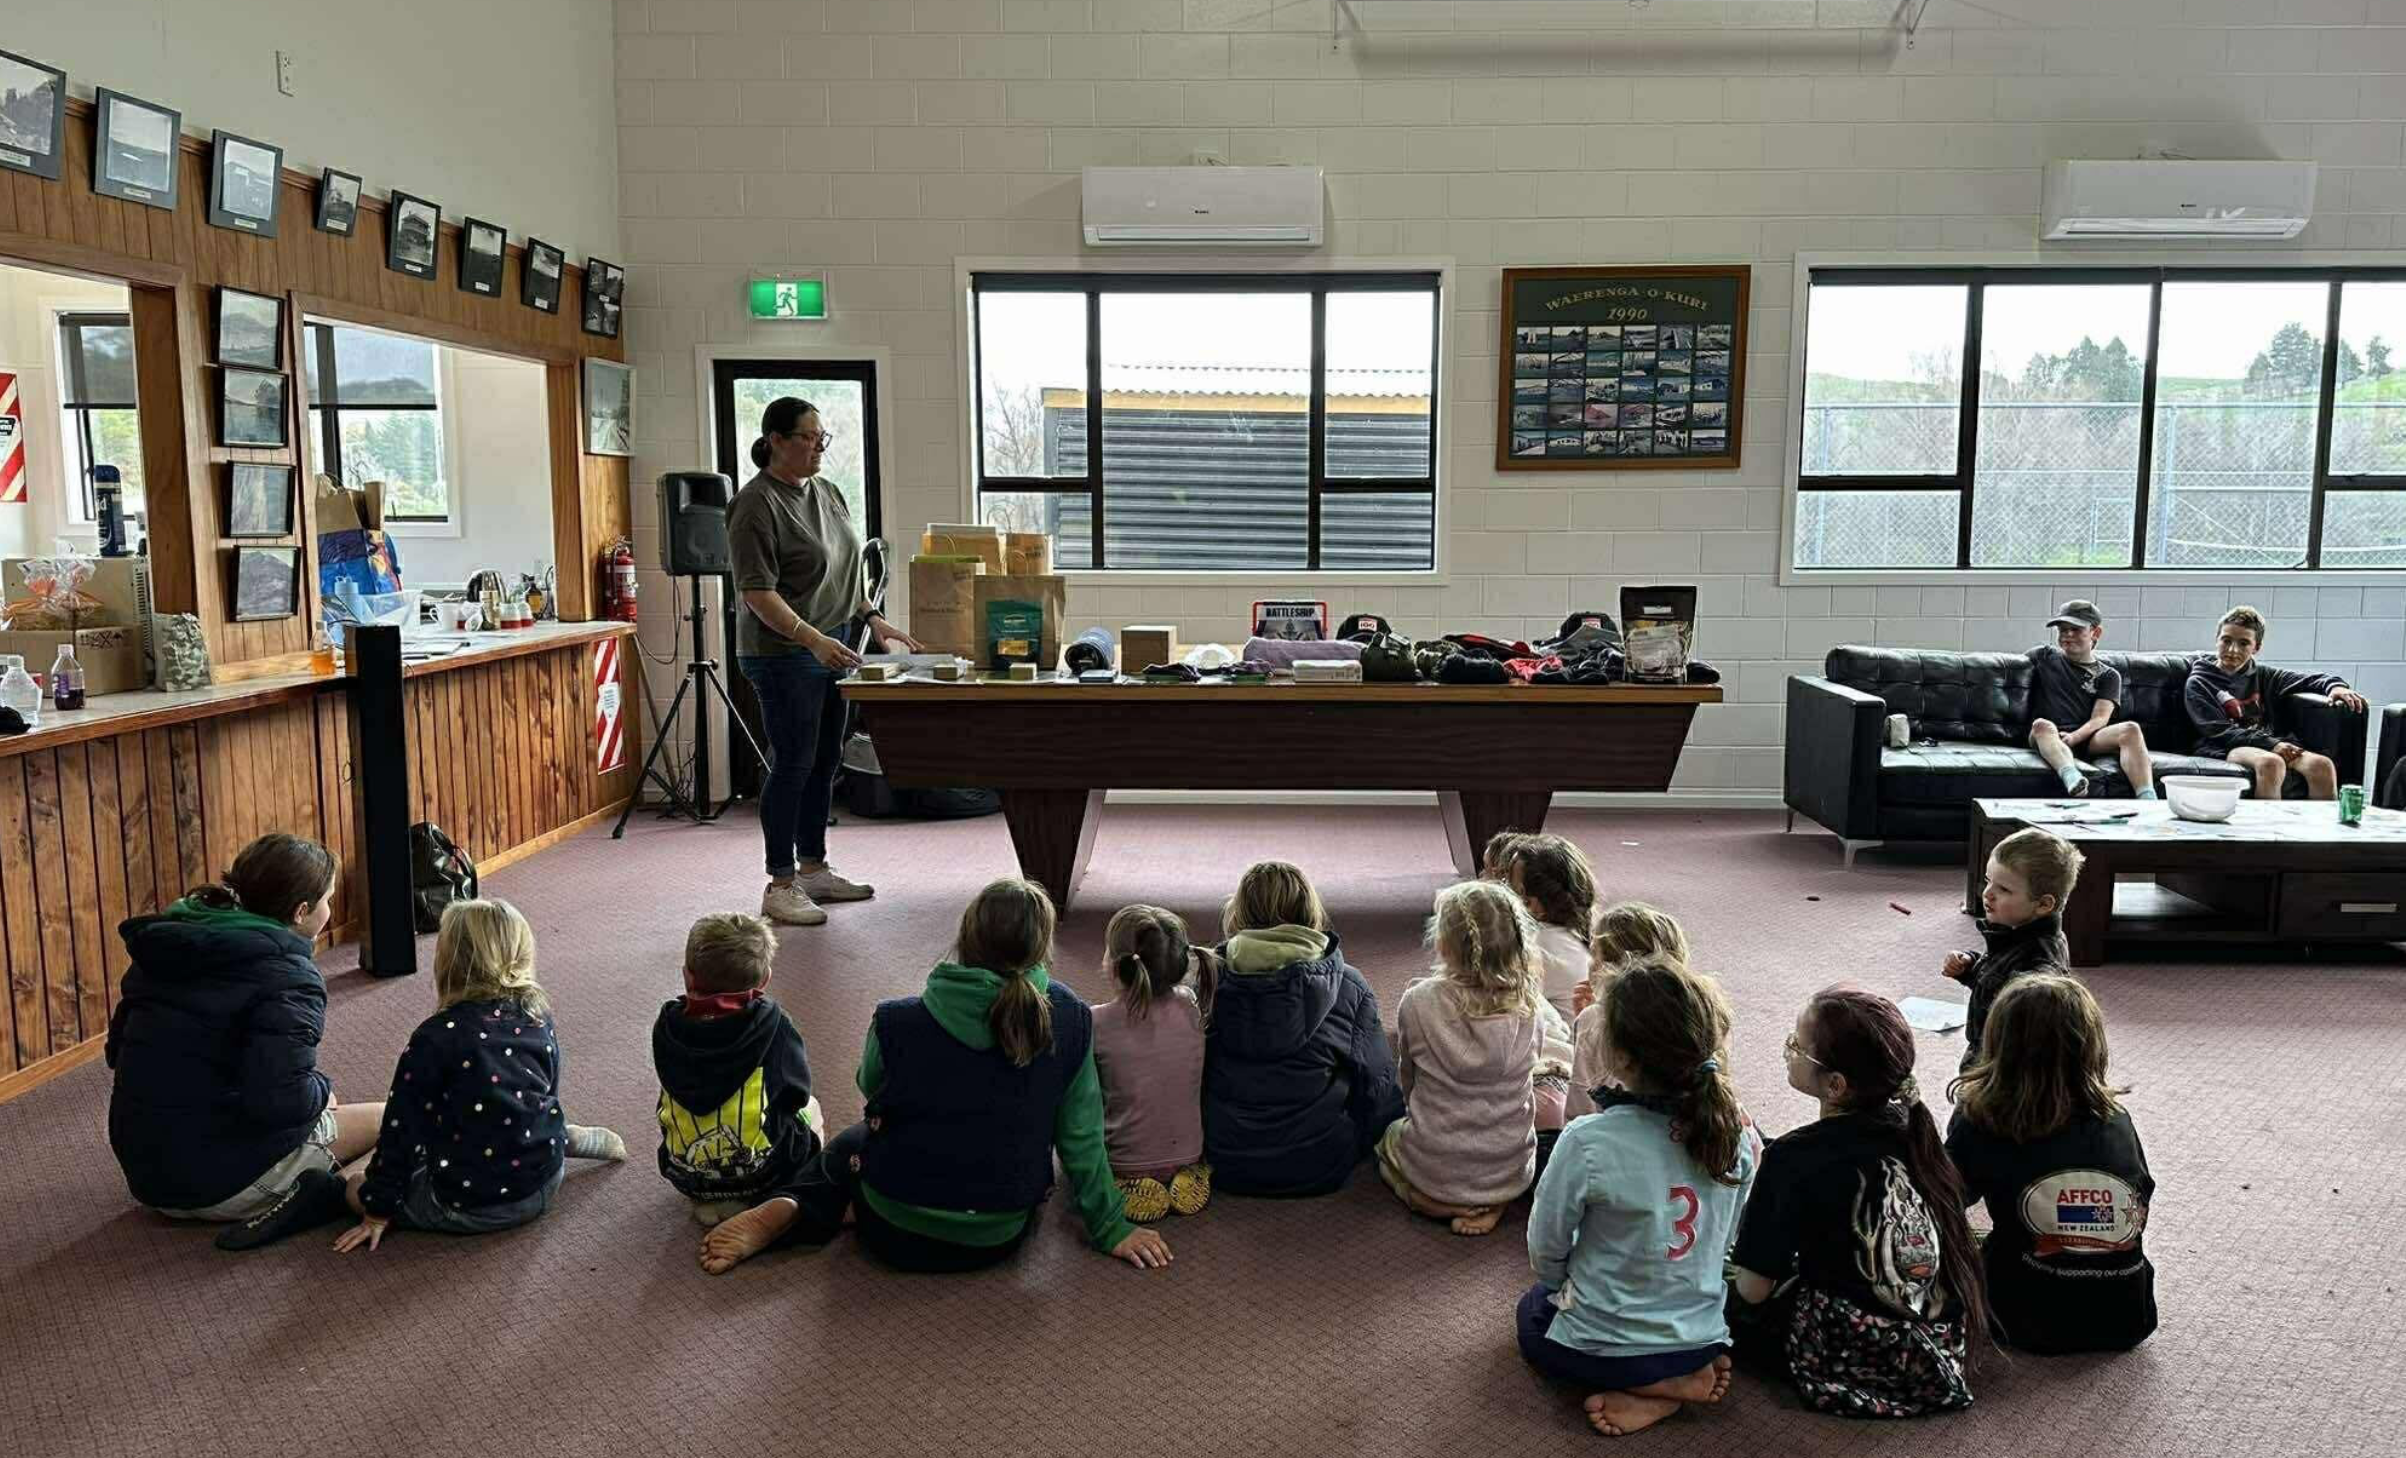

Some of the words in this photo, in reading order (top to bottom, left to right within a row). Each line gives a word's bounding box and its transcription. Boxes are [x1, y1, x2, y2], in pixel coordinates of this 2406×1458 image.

[1606, 307, 1648, 322] 1990
[1266, 607, 1315, 618] BATTLESHIP
[2056, 1188, 2113, 1204] AFFCO
[1665, 1184, 1701, 1261] 3
[2057, 1224, 2077, 1232] NEW
[2079, 1224, 2115, 1232] ZEALAND
